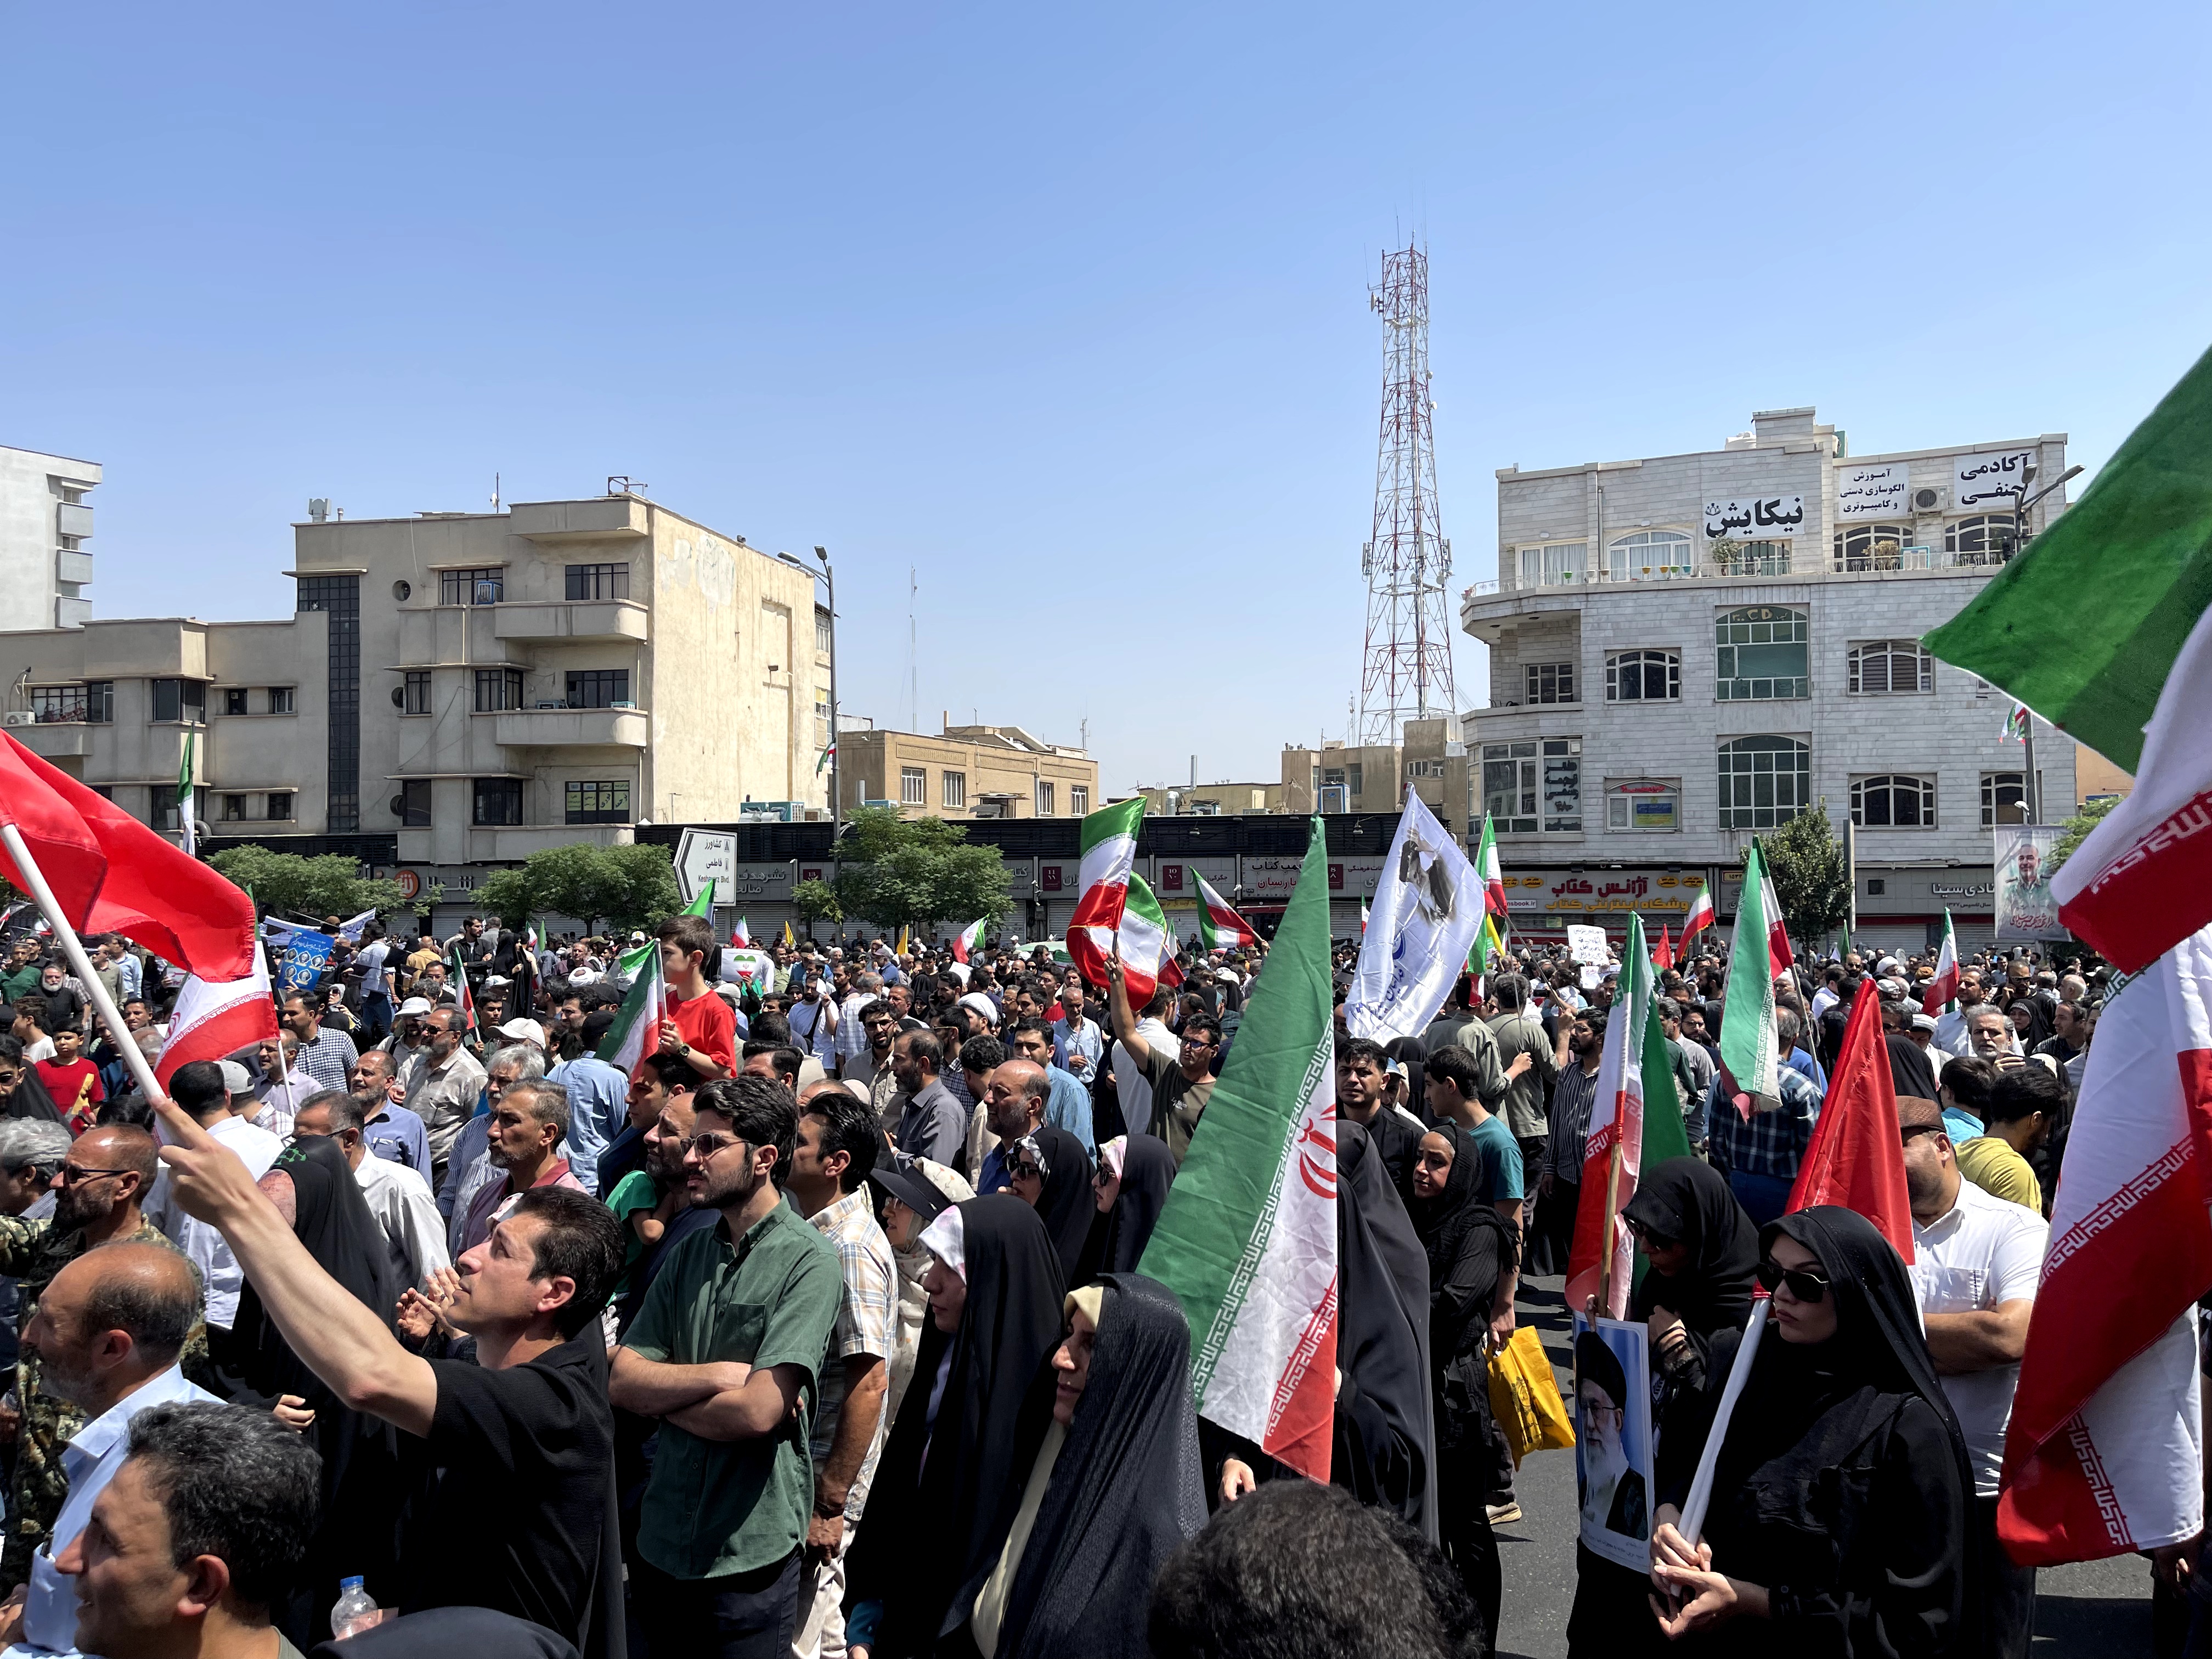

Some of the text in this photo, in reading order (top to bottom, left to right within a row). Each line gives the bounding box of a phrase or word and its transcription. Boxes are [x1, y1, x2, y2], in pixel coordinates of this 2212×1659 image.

[1961, 452, 2031, 481] آکادمی
[1853, 468, 1892, 482] آموزش
[1840, 483, 1904, 498] الگوسازی دستی
[1843, 499, 1891, 512] کامپیوتری
[1706, 497, 1803, 538] نیکایش
[1747, 608, 1773, 620] CD
[704, 838, 722, 850] کشاورز
[706, 858, 723, 869] فاطمی
[1252, 861, 1279, 874] کتاب
[738, 868, 785, 883] نشر هدف
[736, 884, 761, 893] صالح
[1257, 877, 1297, 890] پارسیان
[1551, 876, 1649, 898] آژانس کتاب
[1933, 883, 1963, 898] سینا
[1545, 896, 1689, 912] وشگاه اینترنتی کتاب
